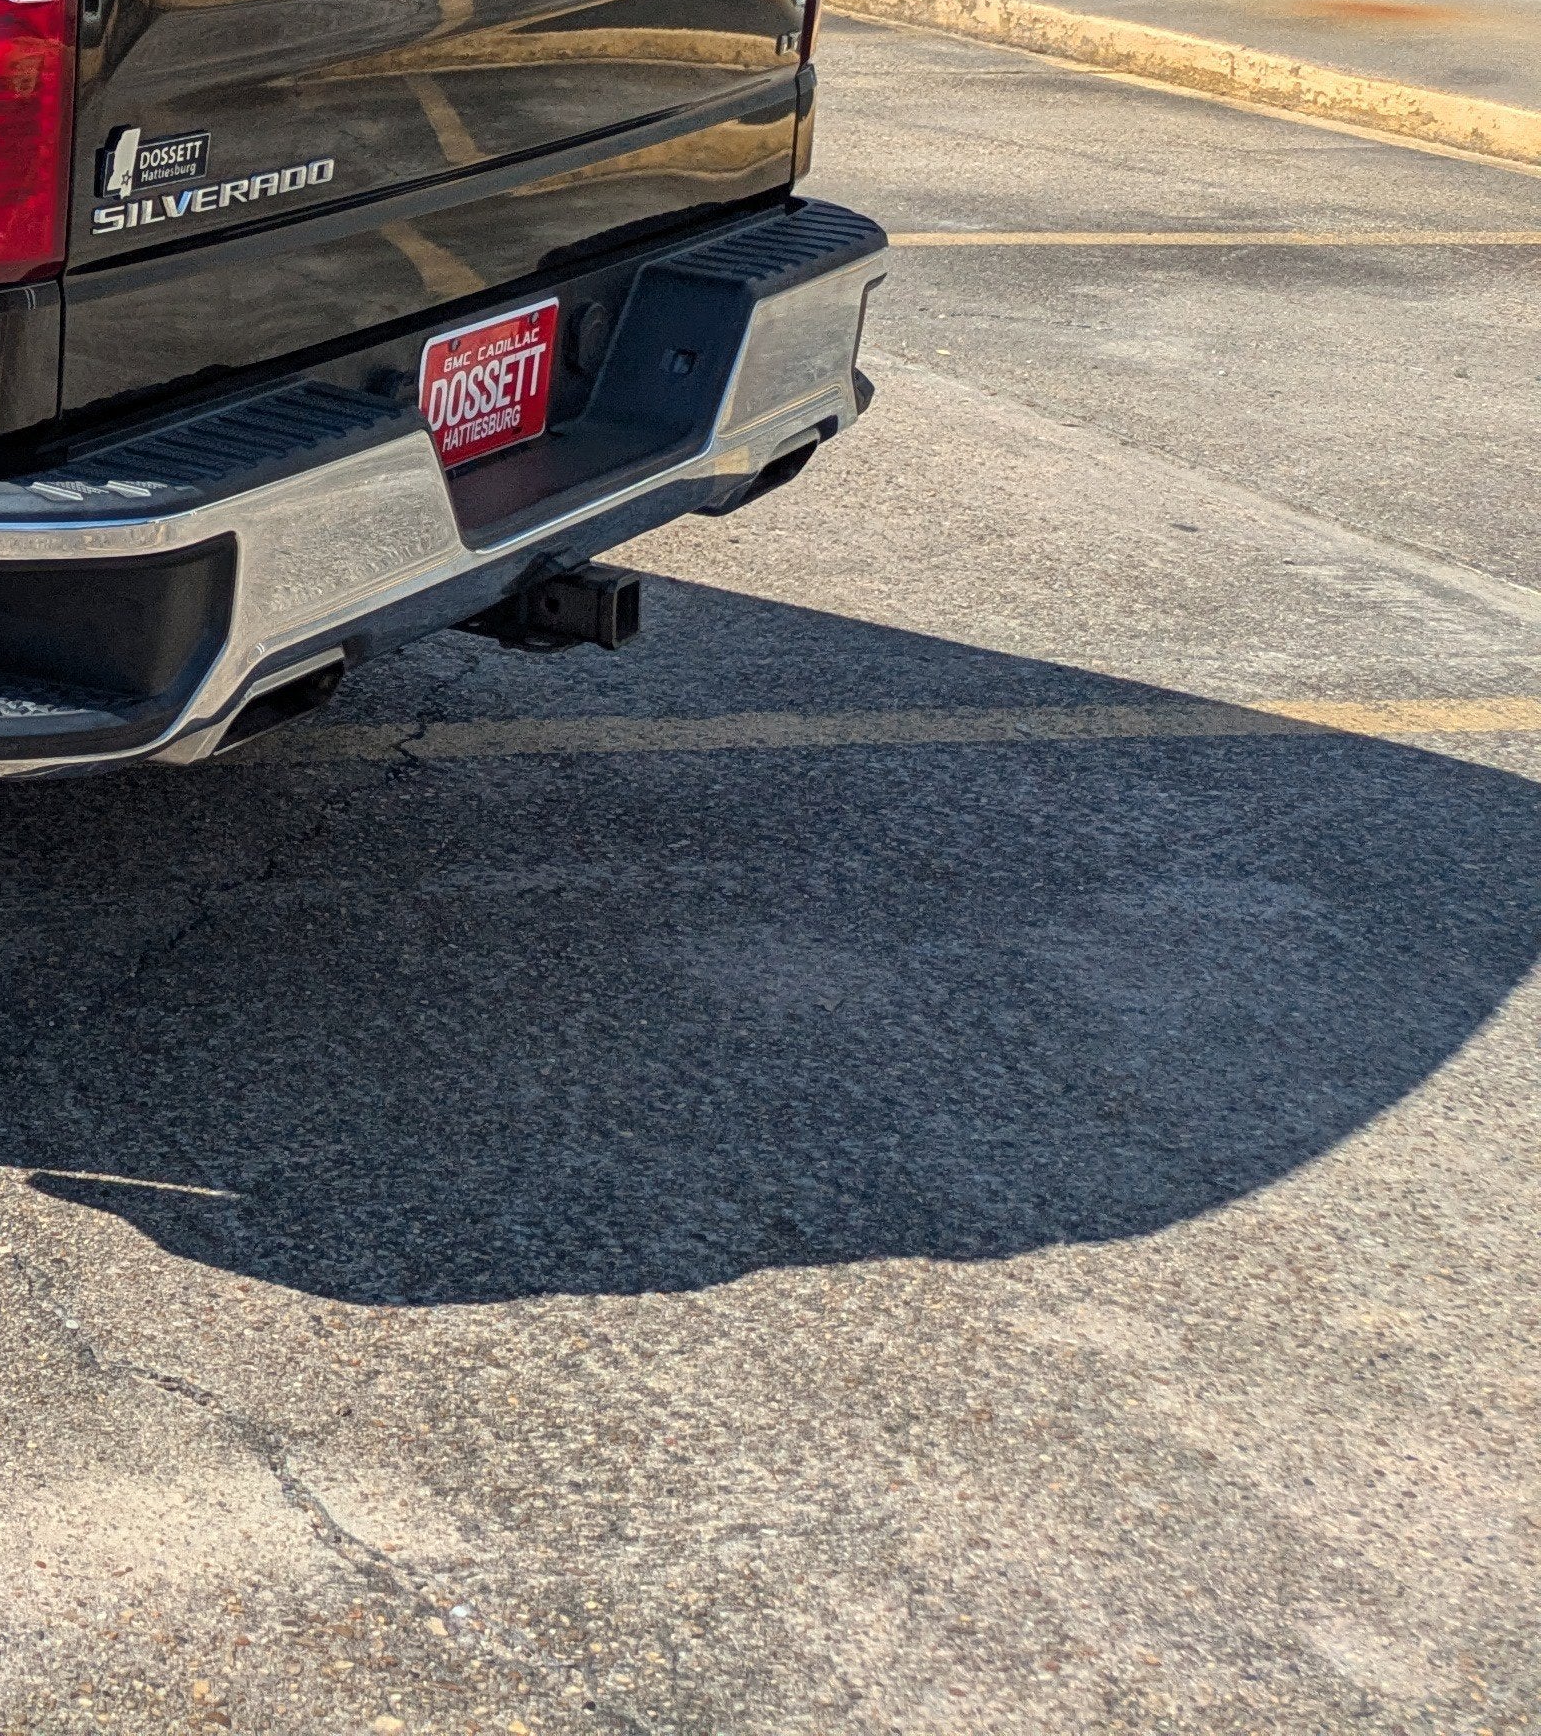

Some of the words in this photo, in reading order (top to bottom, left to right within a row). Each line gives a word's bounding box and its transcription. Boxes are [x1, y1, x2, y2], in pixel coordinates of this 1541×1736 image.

[139, 140, 203, 169] DOSSETT
[140, 162, 197, 183] Hattiesburg
[92, 157, 335, 235] SILVERADO
[443, 350, 472, 373] GMC
[477, 327, 540, 361] CADILLAC
[427, 342, 547, 432] DOSSETT
[442, 404, 522, 453] HATTIESBURG
